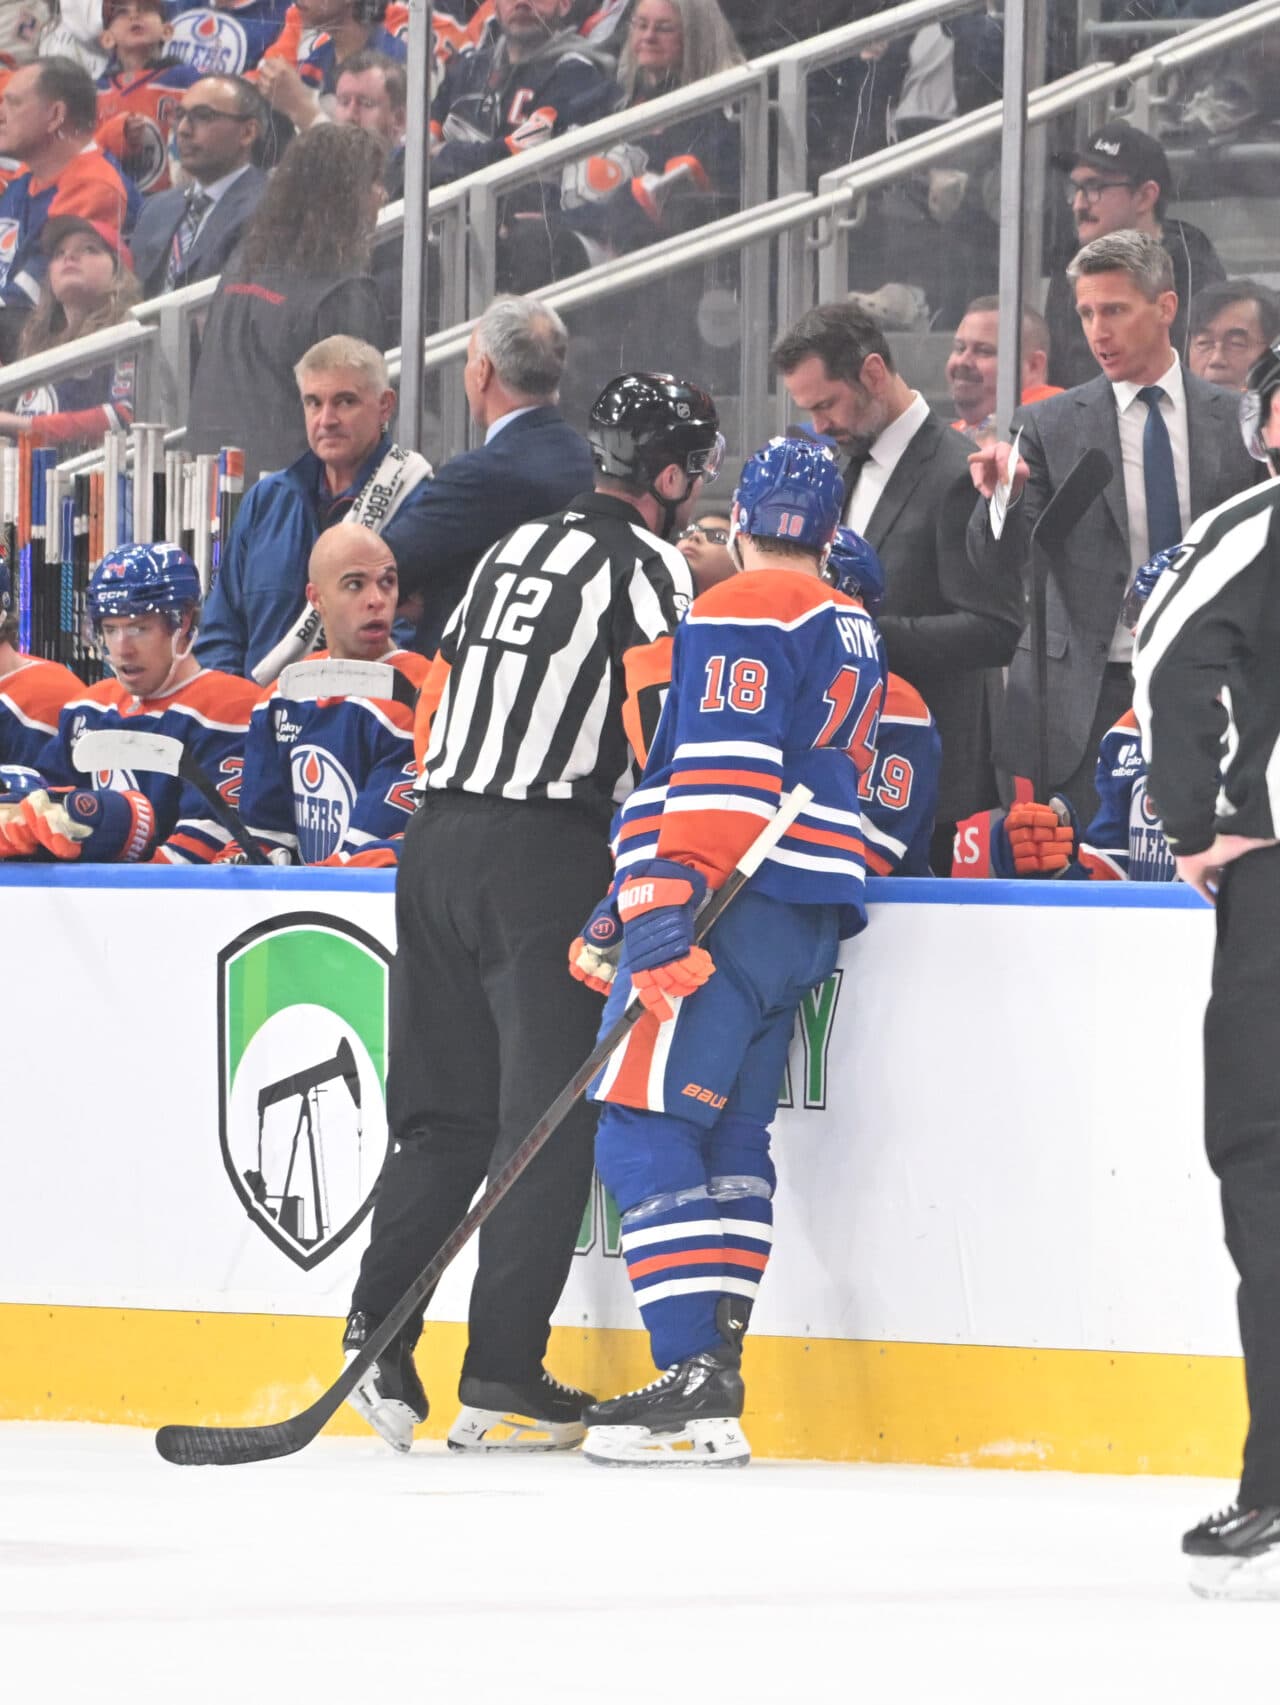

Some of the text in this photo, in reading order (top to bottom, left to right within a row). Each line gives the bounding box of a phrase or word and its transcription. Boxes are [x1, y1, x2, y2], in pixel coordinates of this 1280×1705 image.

[97, 589, 129, 601] CCM
[480, 571, 553, 646] 12
[835, 616, 881, 663] HYM
[699, 655, 769, 714] 18
[1111, 766, 1141, 778] alber
[1125, 754, 1142, 767] pla
